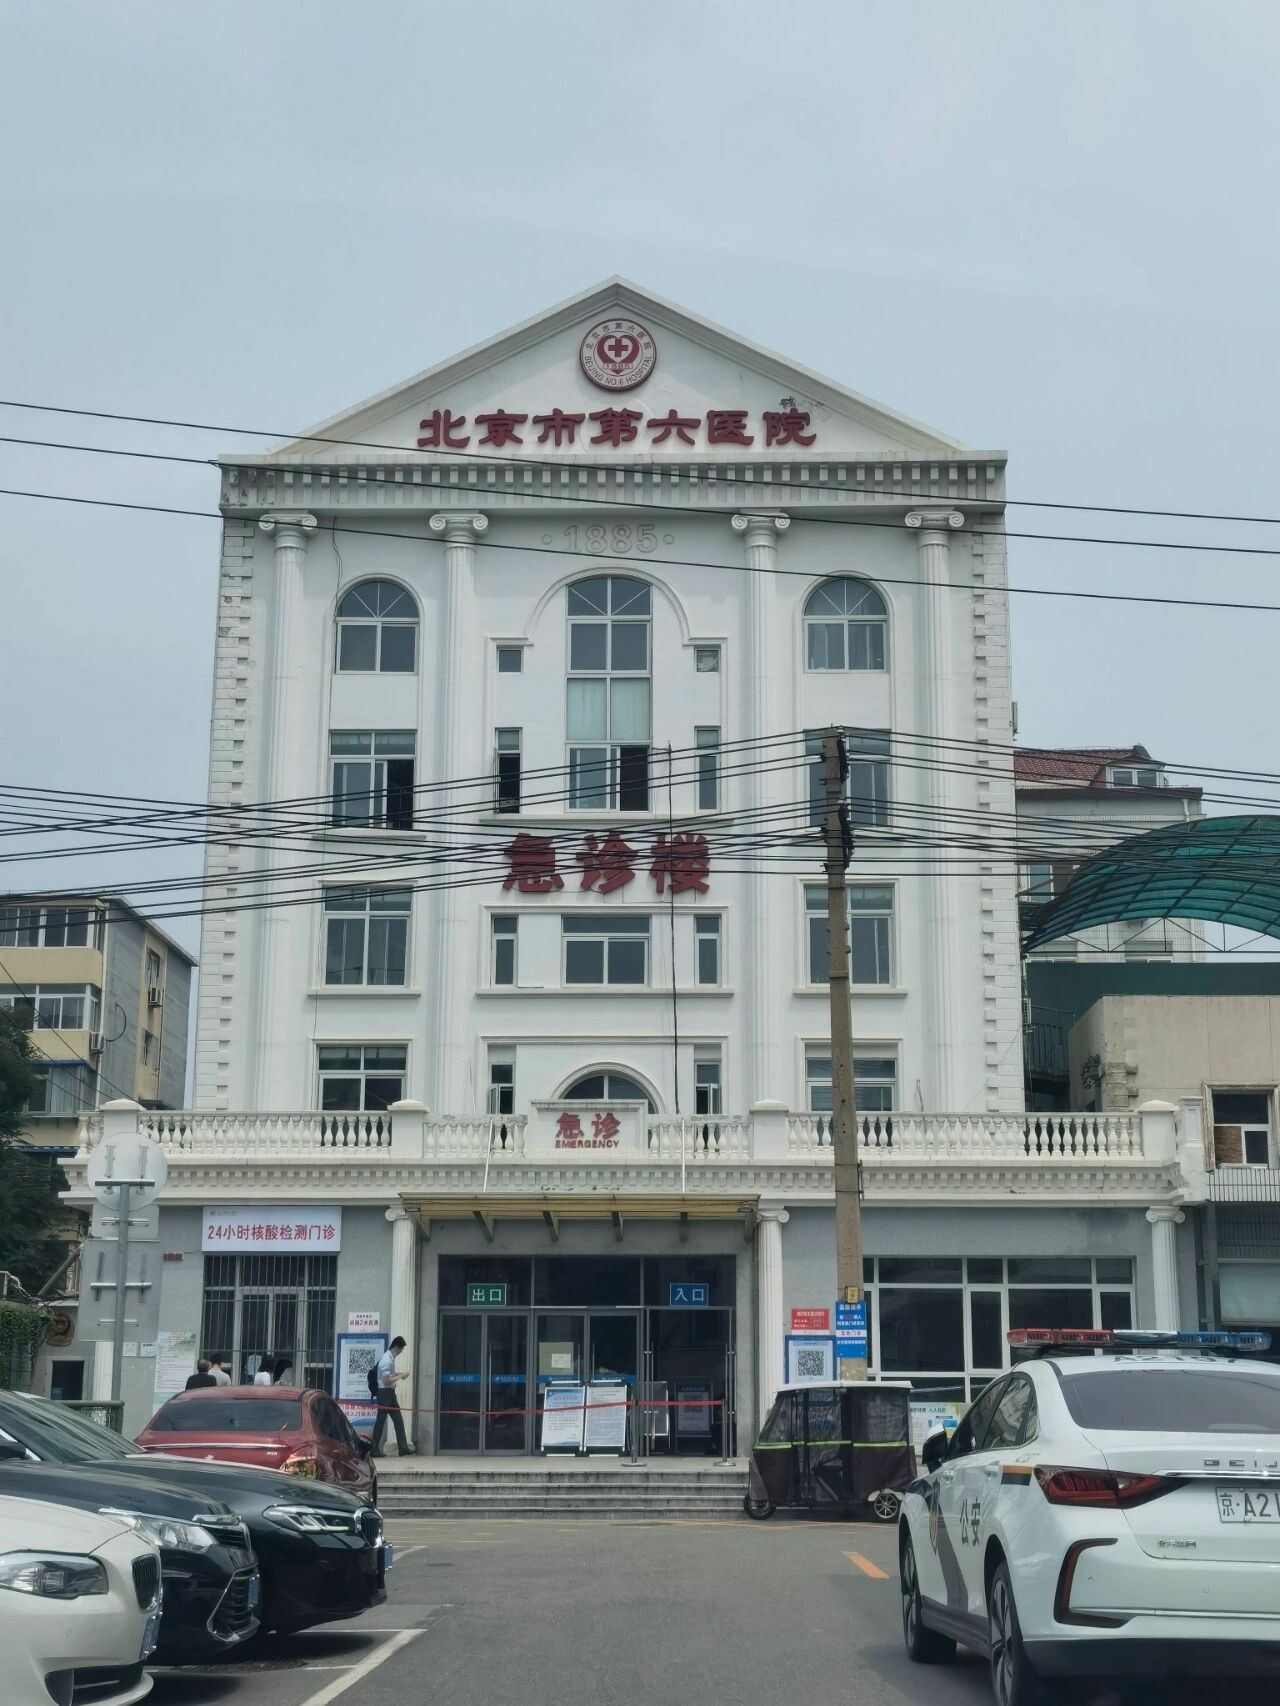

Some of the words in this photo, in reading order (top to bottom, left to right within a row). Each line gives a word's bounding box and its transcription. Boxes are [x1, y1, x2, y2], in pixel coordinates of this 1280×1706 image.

[584, 355, 604, 381] BEIJING
[626, 356, 652, 384] HOSPITAL
[416, 407, 817, 448] 北京市第六医院
[563, 524, 658, 553] 1885
[502, 832, 710, 894] 急诊楼
[555, 1112, 621, 1139] 急诊
[555, 1139, 620, 1149] EMERGENCY
[207, 1224, 336, 1241] 24小时核酸检测门诊
[471, 1288, 502, 1302] 出口
[674, 1287, 705, 1302] 入口
[1219, 1492, 1280, 1517] 京·A2
